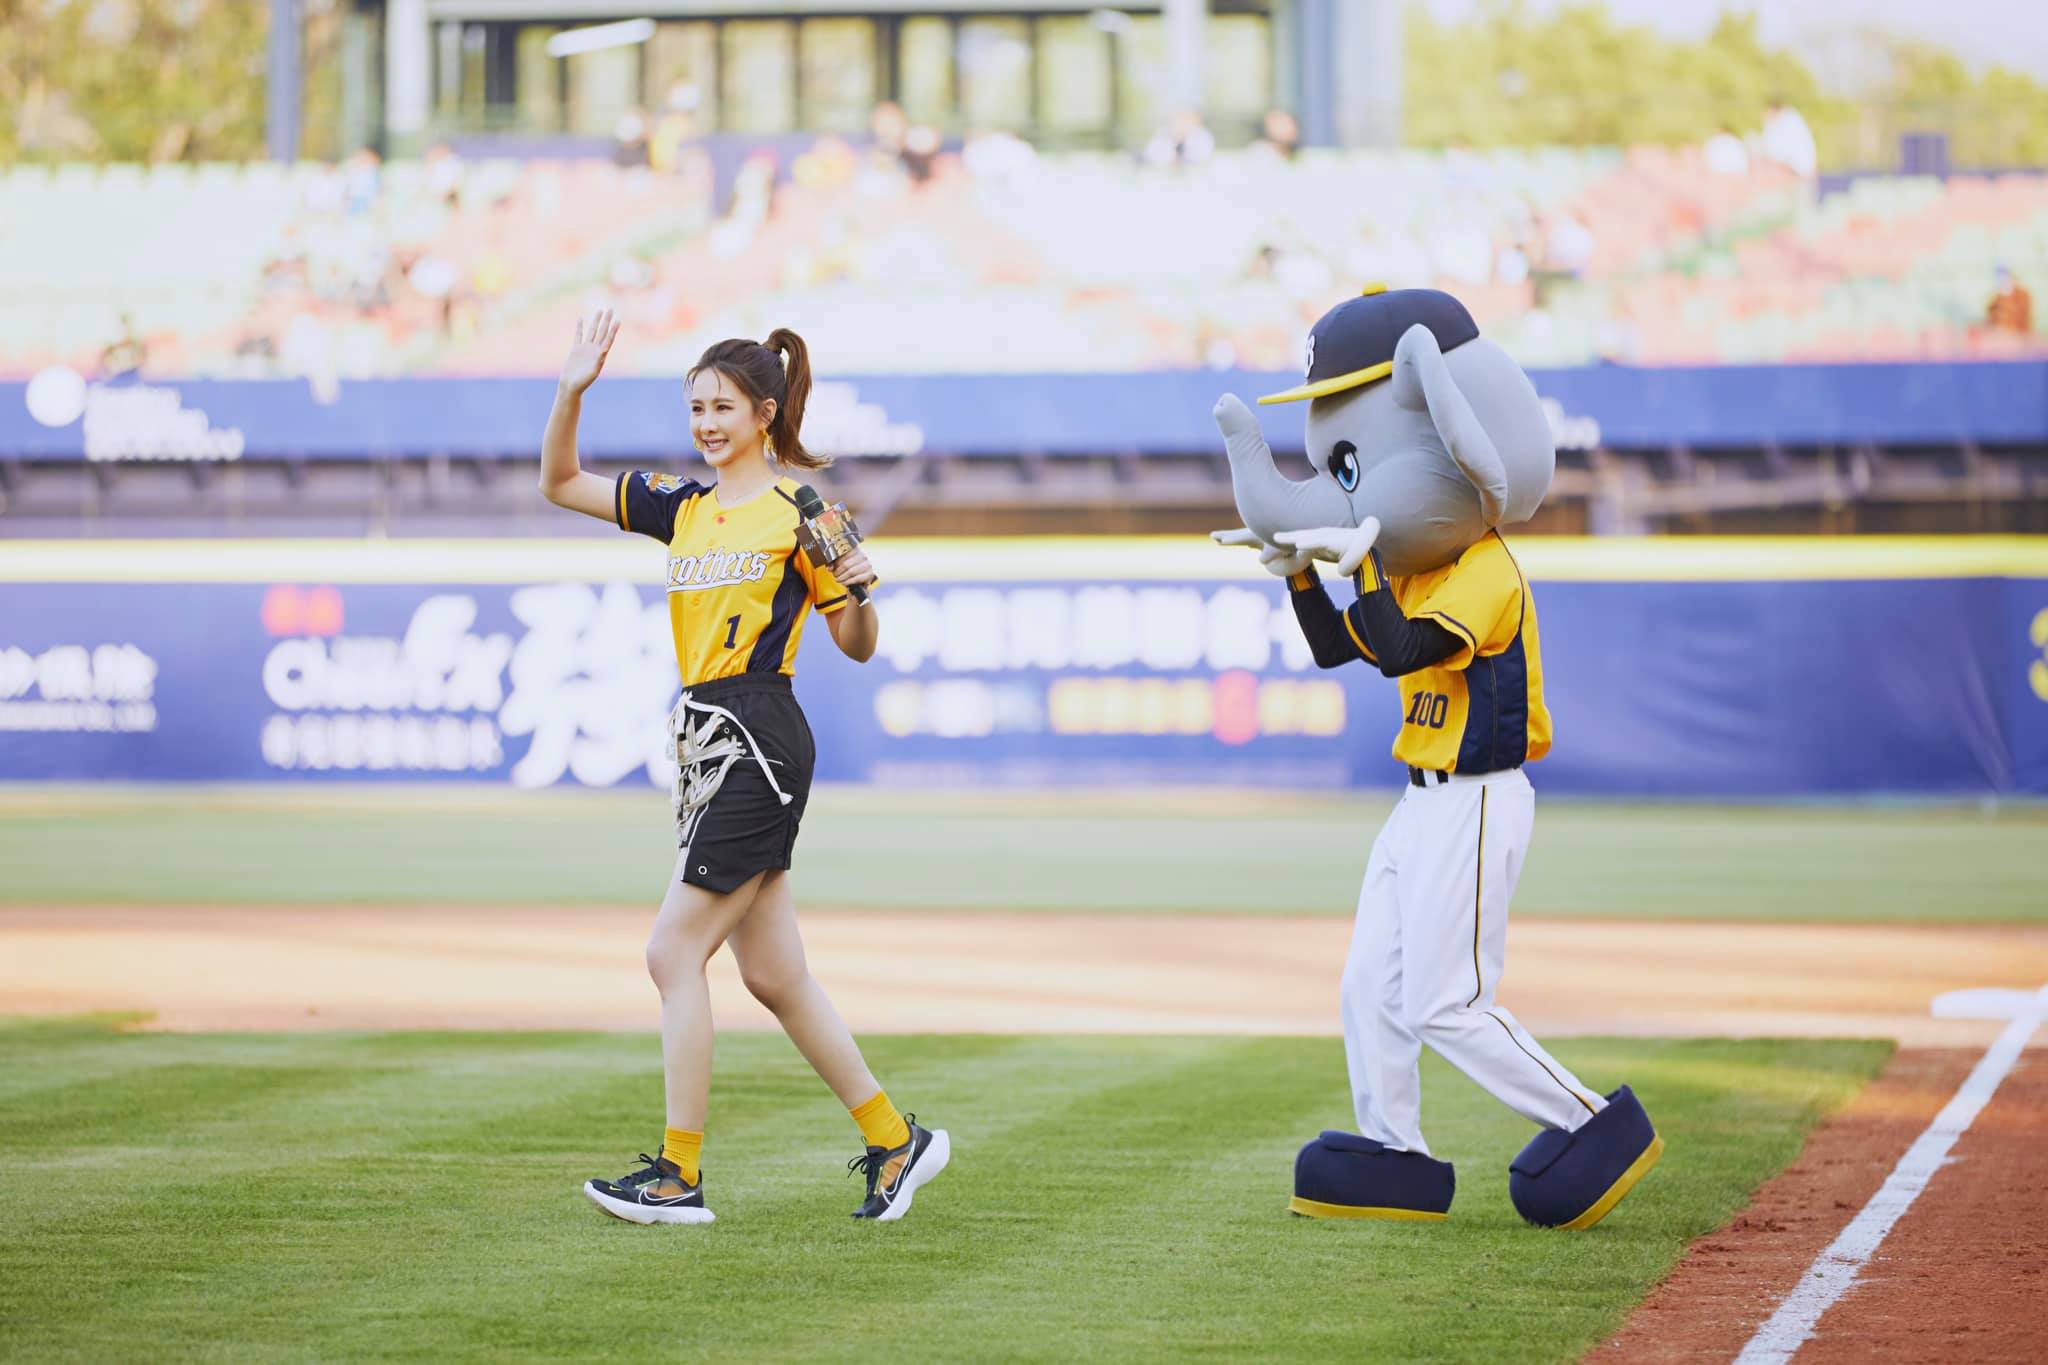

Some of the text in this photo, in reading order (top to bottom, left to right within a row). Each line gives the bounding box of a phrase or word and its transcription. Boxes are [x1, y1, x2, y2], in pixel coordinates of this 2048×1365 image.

[667, 547, 771, 590] rothers
[724, 614, 741, 649] 1
[1405, 690, 1449, 729] 100
